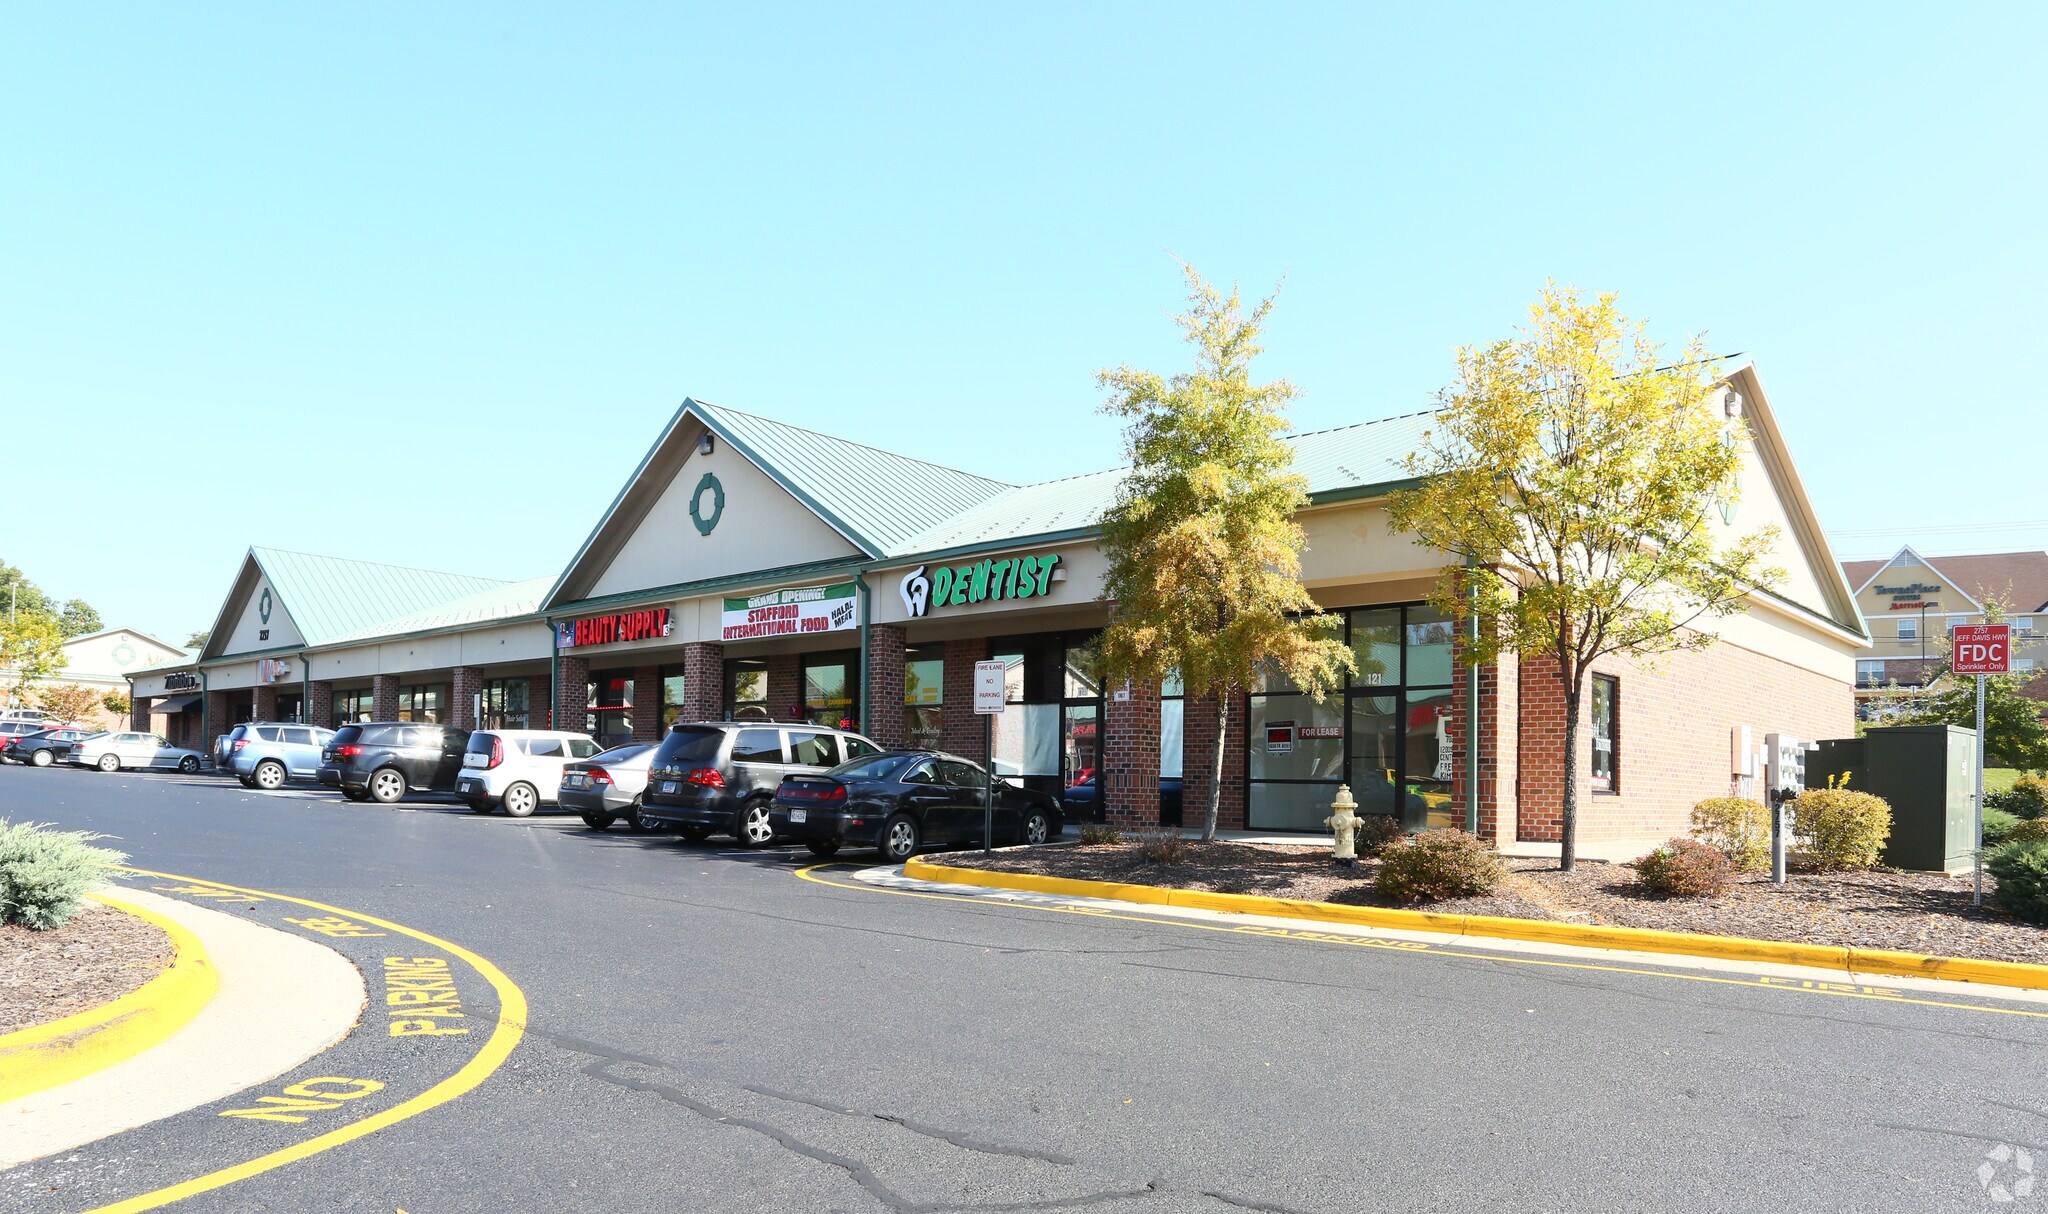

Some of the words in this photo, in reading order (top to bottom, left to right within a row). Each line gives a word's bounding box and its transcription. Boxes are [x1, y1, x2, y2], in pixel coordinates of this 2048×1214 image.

[933, 554, 1060, 606] DENTIST
[748, 592, 779, 608] GRAND
[782, 588, 826, 602] OPENING!
[748, 605, 799, 623] STAFFORD
[831, 601, 853, 620] HALAL
[834, 610, 852, 628] MEAT
[575, 615, 618, 647] BEAUTY
[620, 608, 669, 641] SUPPLY
[723, 620, 797, 639] INTERNATIONAL
[801, 616, 829, 632] FOOD
[1960, 644, 2002, 662] FDC
[1368, 673, 1382, 684] 121
[1317, 728, 1338, 736] LEASE
[1233, 926, 1430, 949] PARKING
[1760, 977, 1904, 998] FIRE
[217, 1076, 386, 1123] NO
[384, 957, 469, 1037] PARKING
